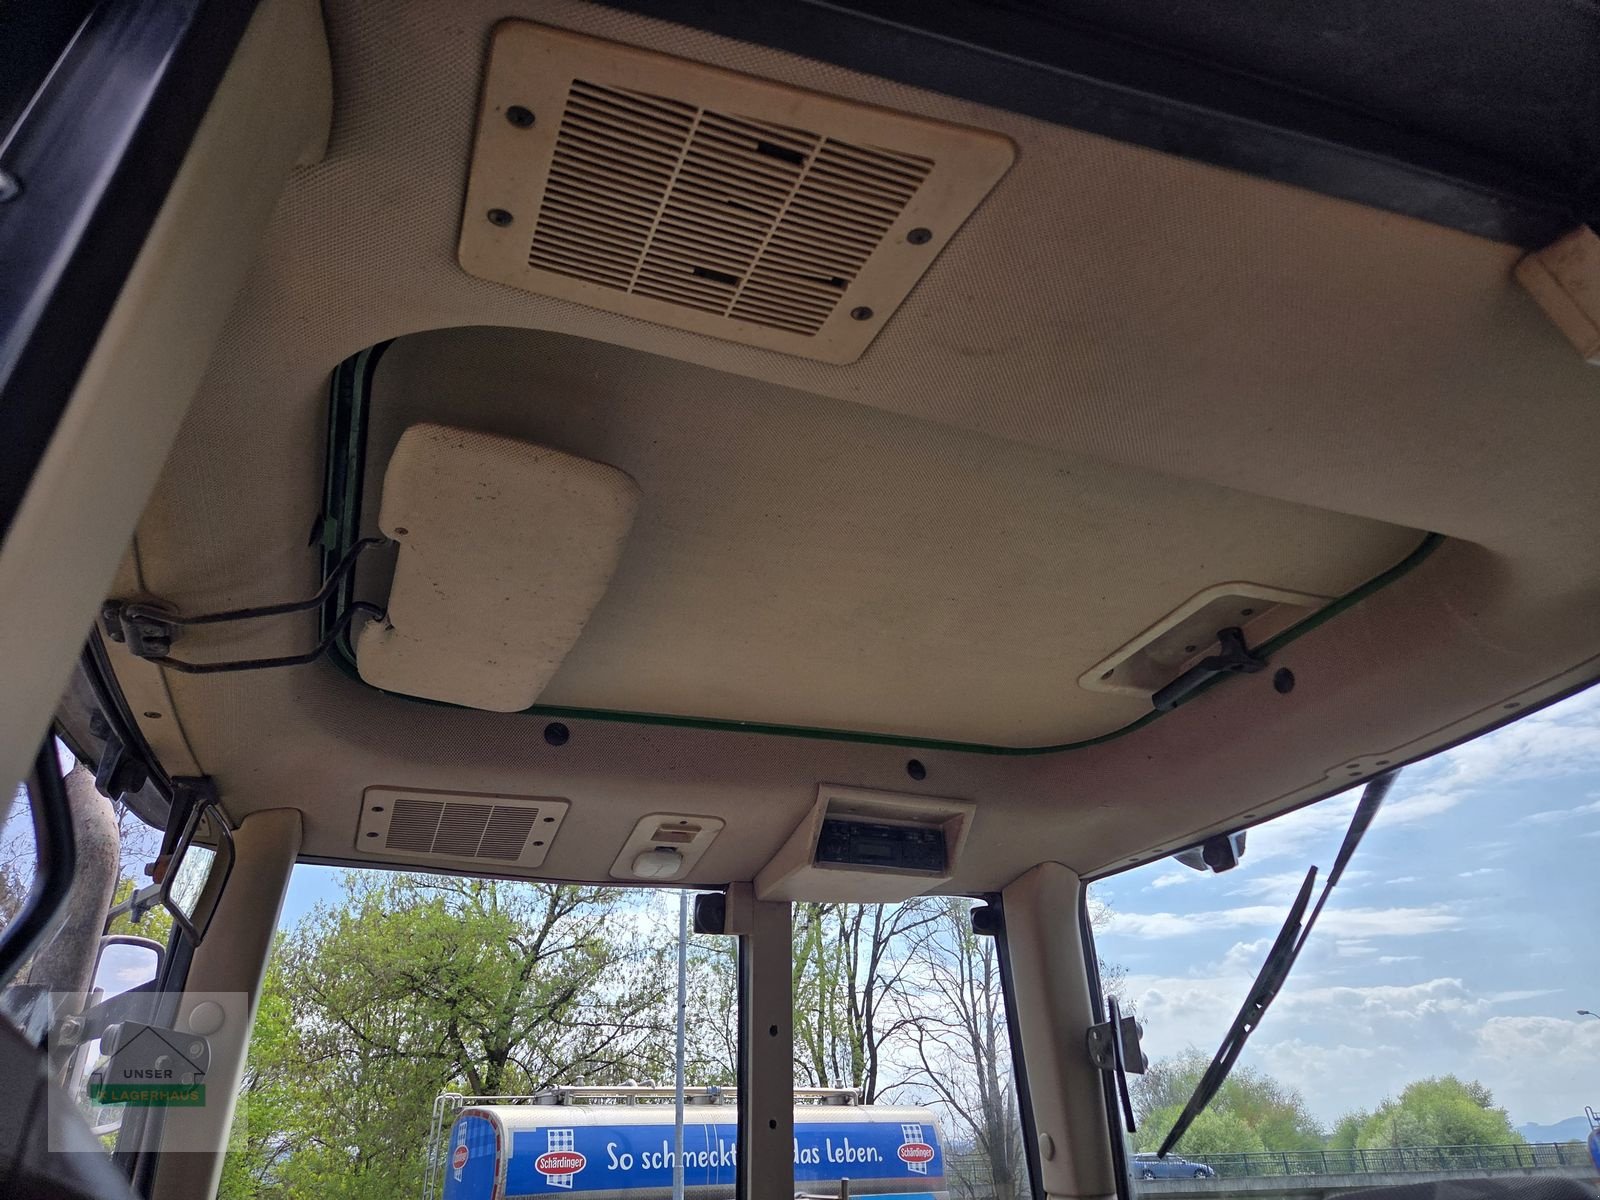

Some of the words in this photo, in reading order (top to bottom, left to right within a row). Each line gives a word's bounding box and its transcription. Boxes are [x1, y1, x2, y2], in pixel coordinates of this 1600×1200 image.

[539, 1156, 584, 1169] Schärdinger
[606, 1140, 635, 1171] So
[641, 1138, 737, 1170] schmeckt
[825, 1136, 883, 1164] Leben.
